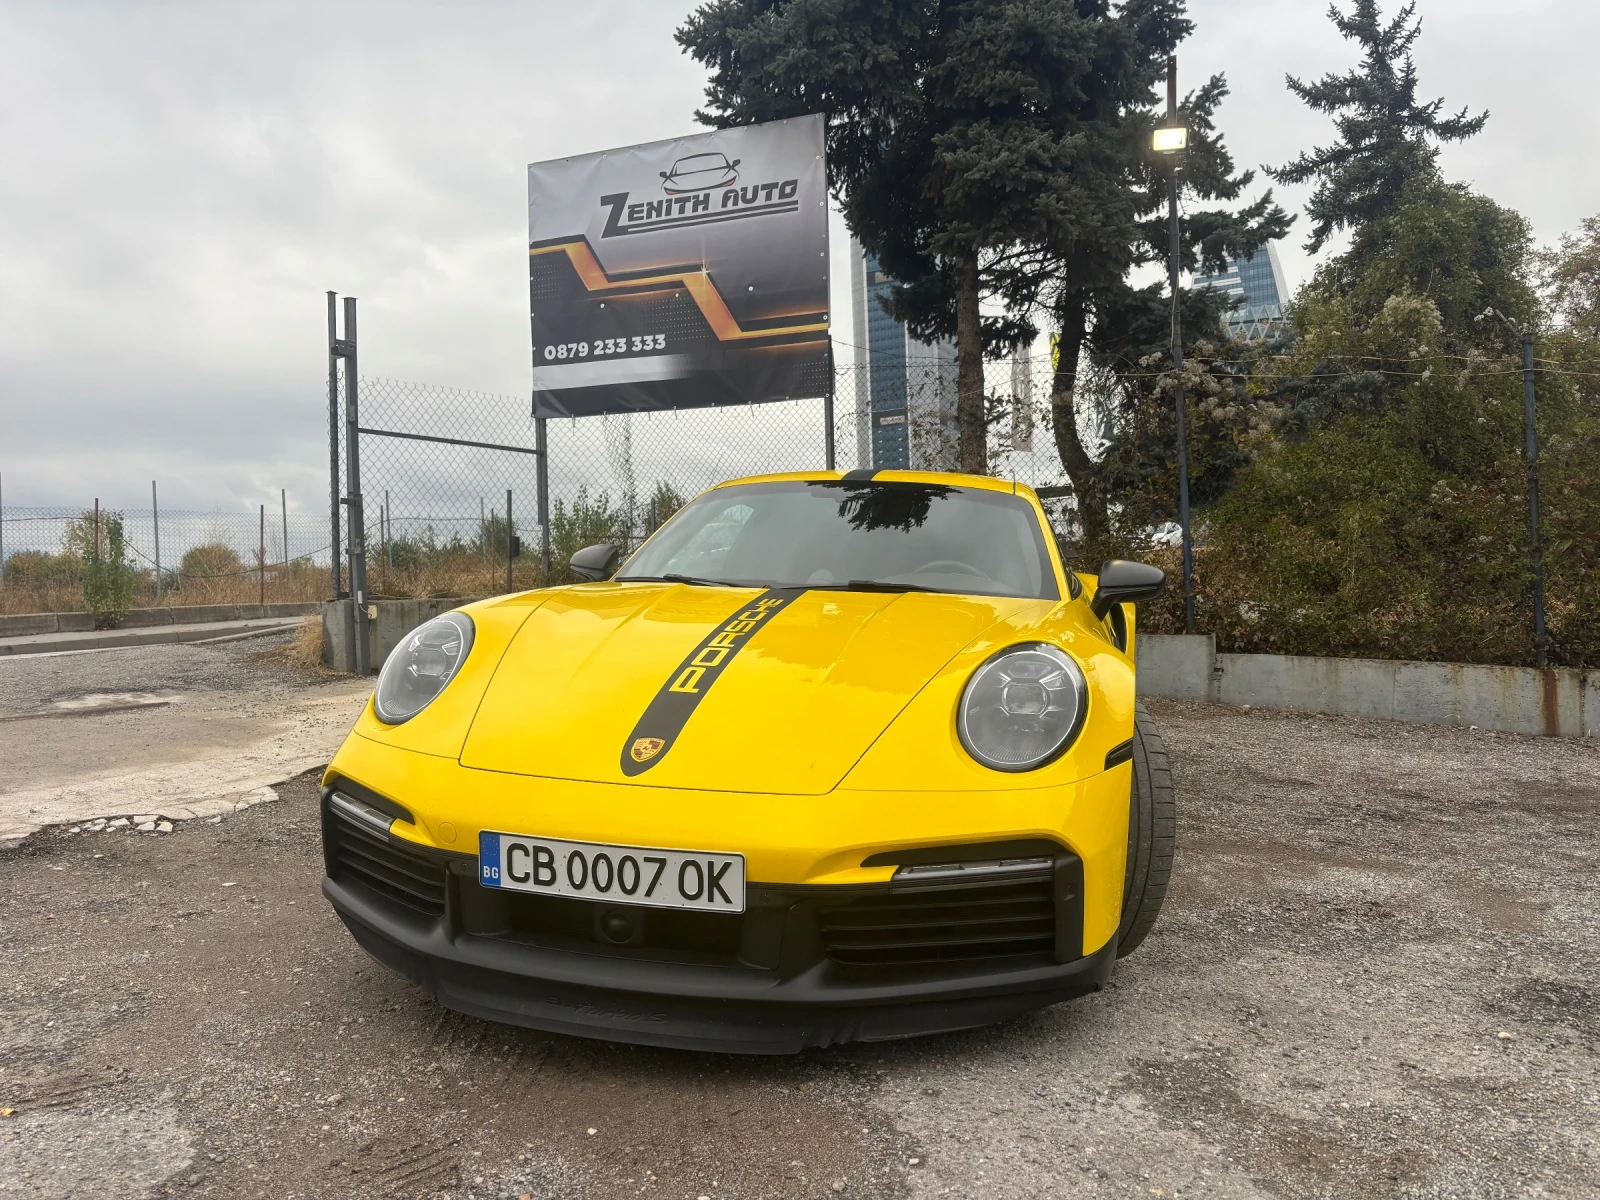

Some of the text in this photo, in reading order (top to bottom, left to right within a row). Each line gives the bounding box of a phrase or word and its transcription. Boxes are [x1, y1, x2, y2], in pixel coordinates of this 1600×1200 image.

[600, 179, 799, 239] ZENITH AUTO
[544, 333, 666, 360] 0879 233 333
[668, 598, 784, 693] PORSCHE
[483, 865, 499, 879] BG
[506, 842, 734, 905] CB 0007 OK
